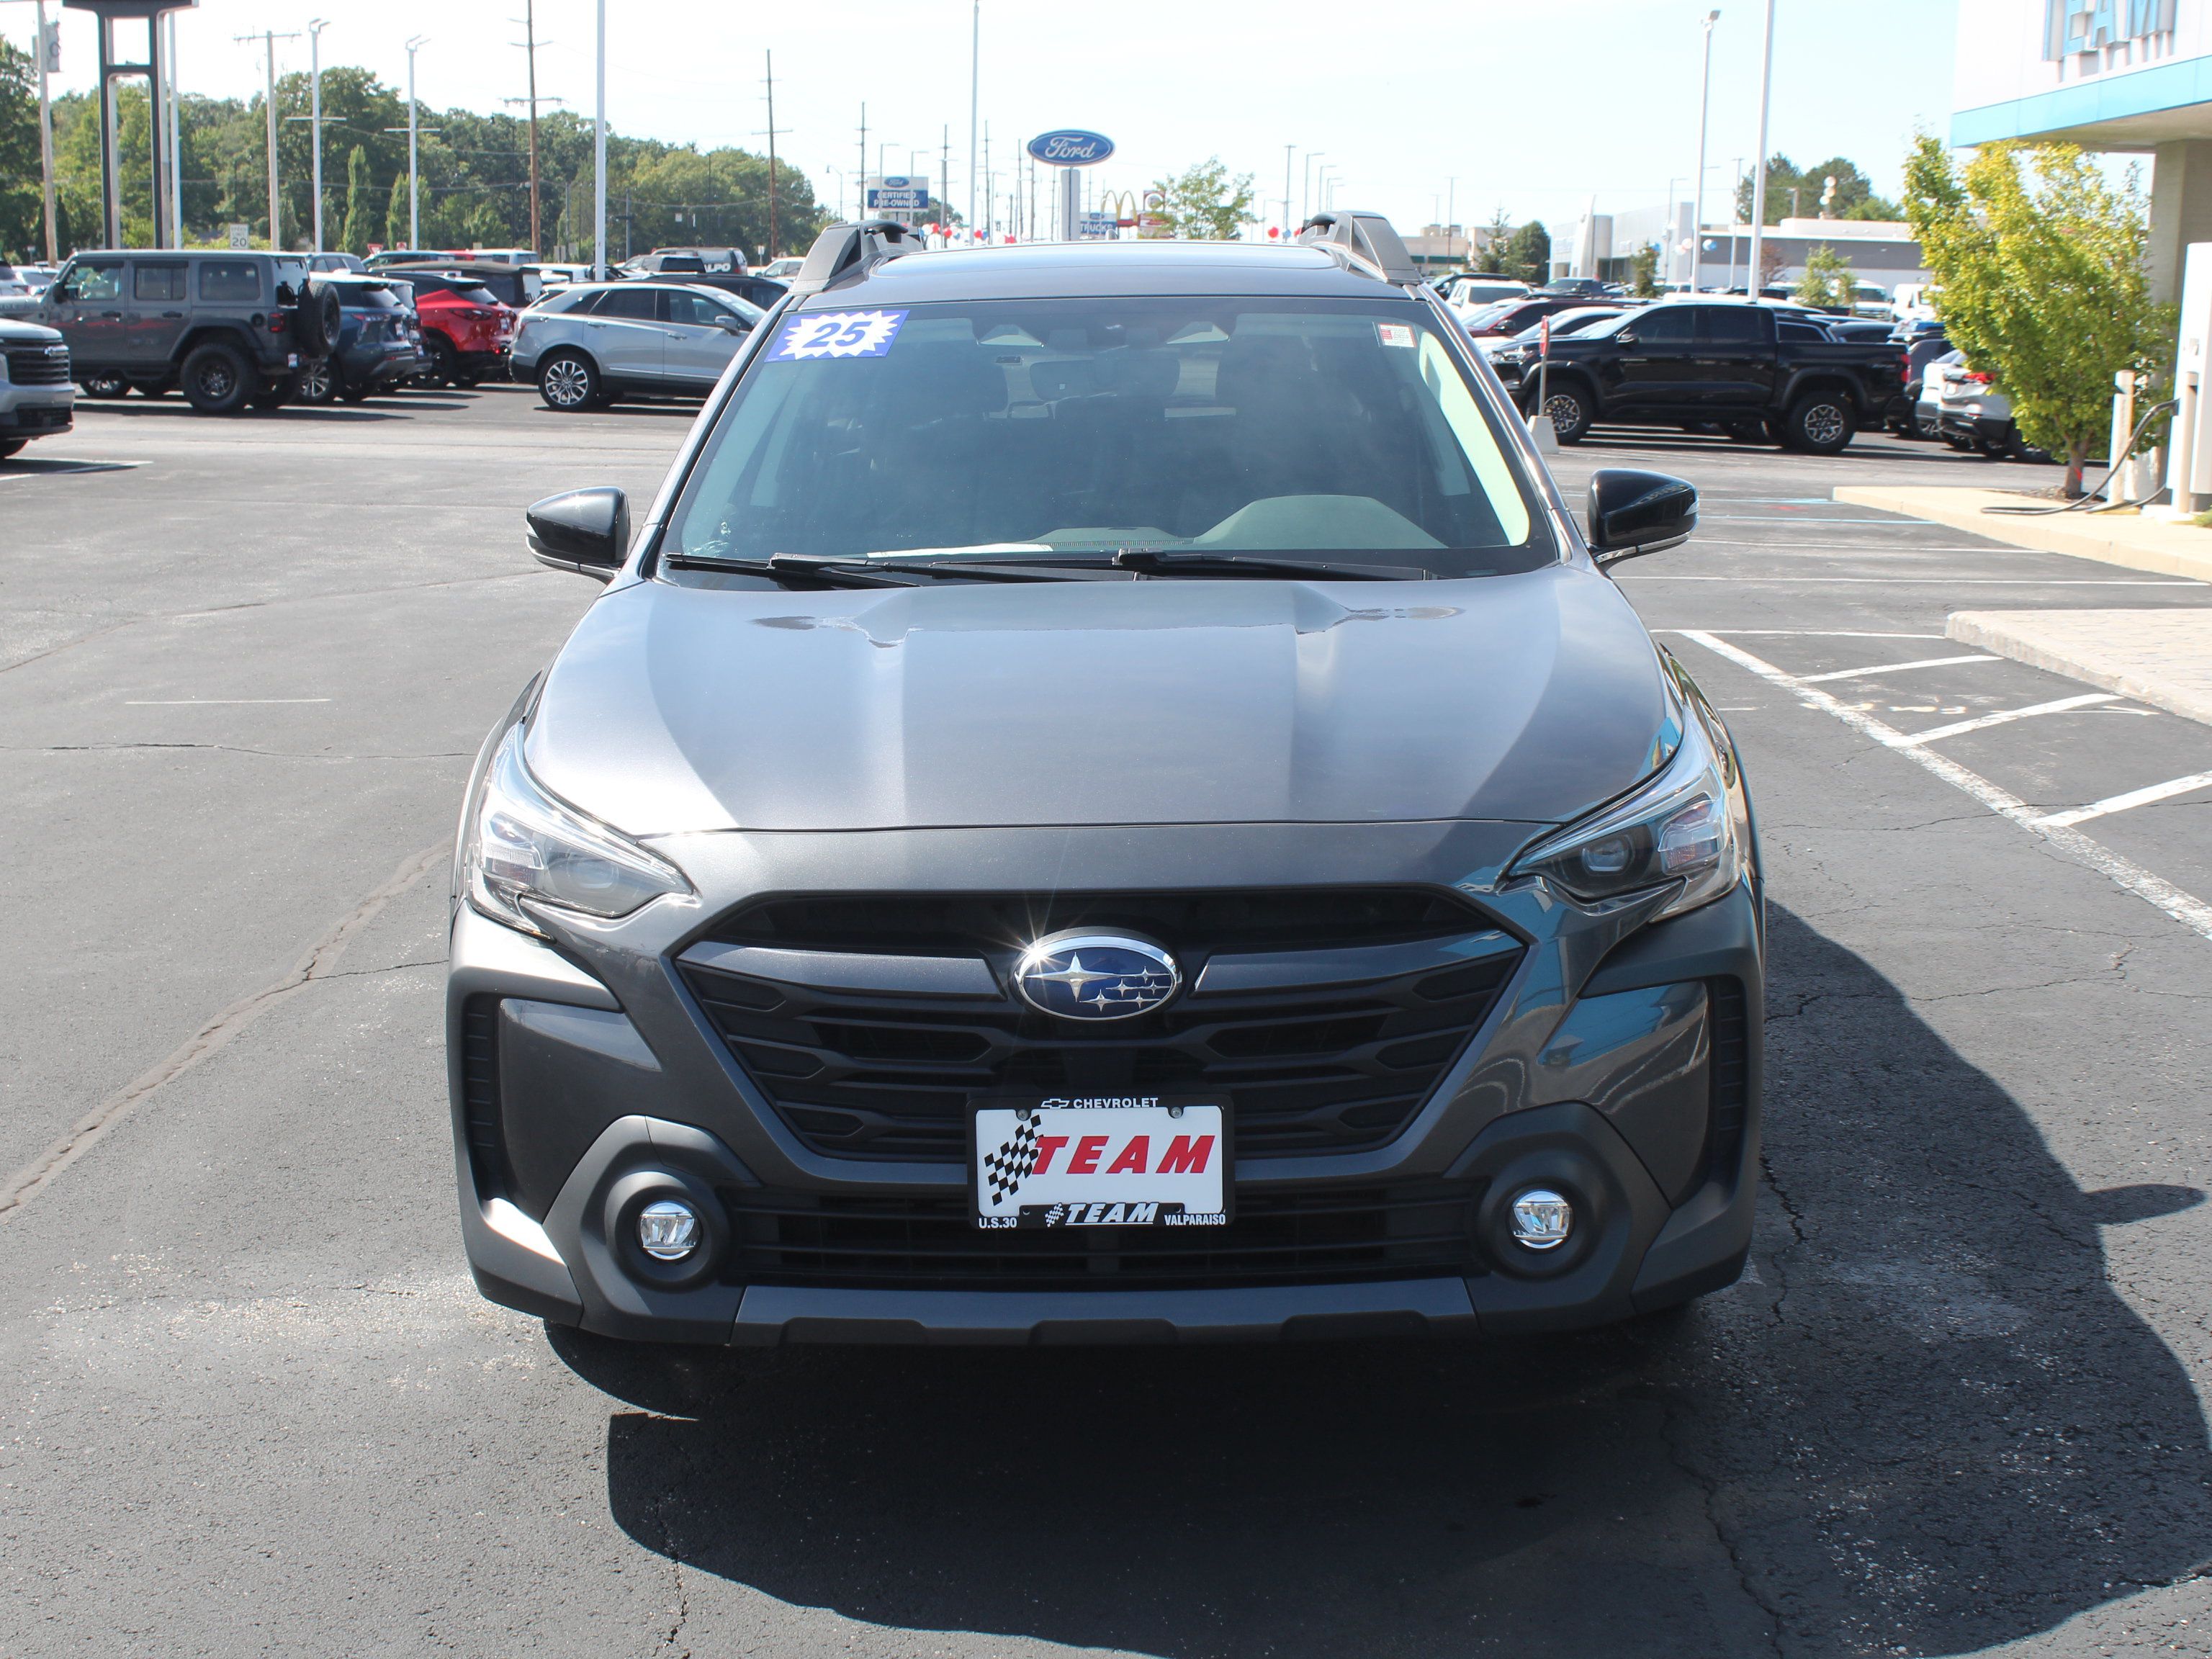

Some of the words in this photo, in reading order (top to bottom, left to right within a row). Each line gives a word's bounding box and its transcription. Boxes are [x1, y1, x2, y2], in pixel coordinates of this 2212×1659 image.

[1045, 136, 1096, 158] Ford
[232, 238, 247, 247] 20
[801, 320, 873, 349] 25
[1073, 1097, 1159, 1109] CHEVROLET
[1032, 1135, 1215, 1174] TEAM
[1067, 1202, 1159, 1223] TEAM
[1164, 1214, 1226, 1226] VALPARAISO
